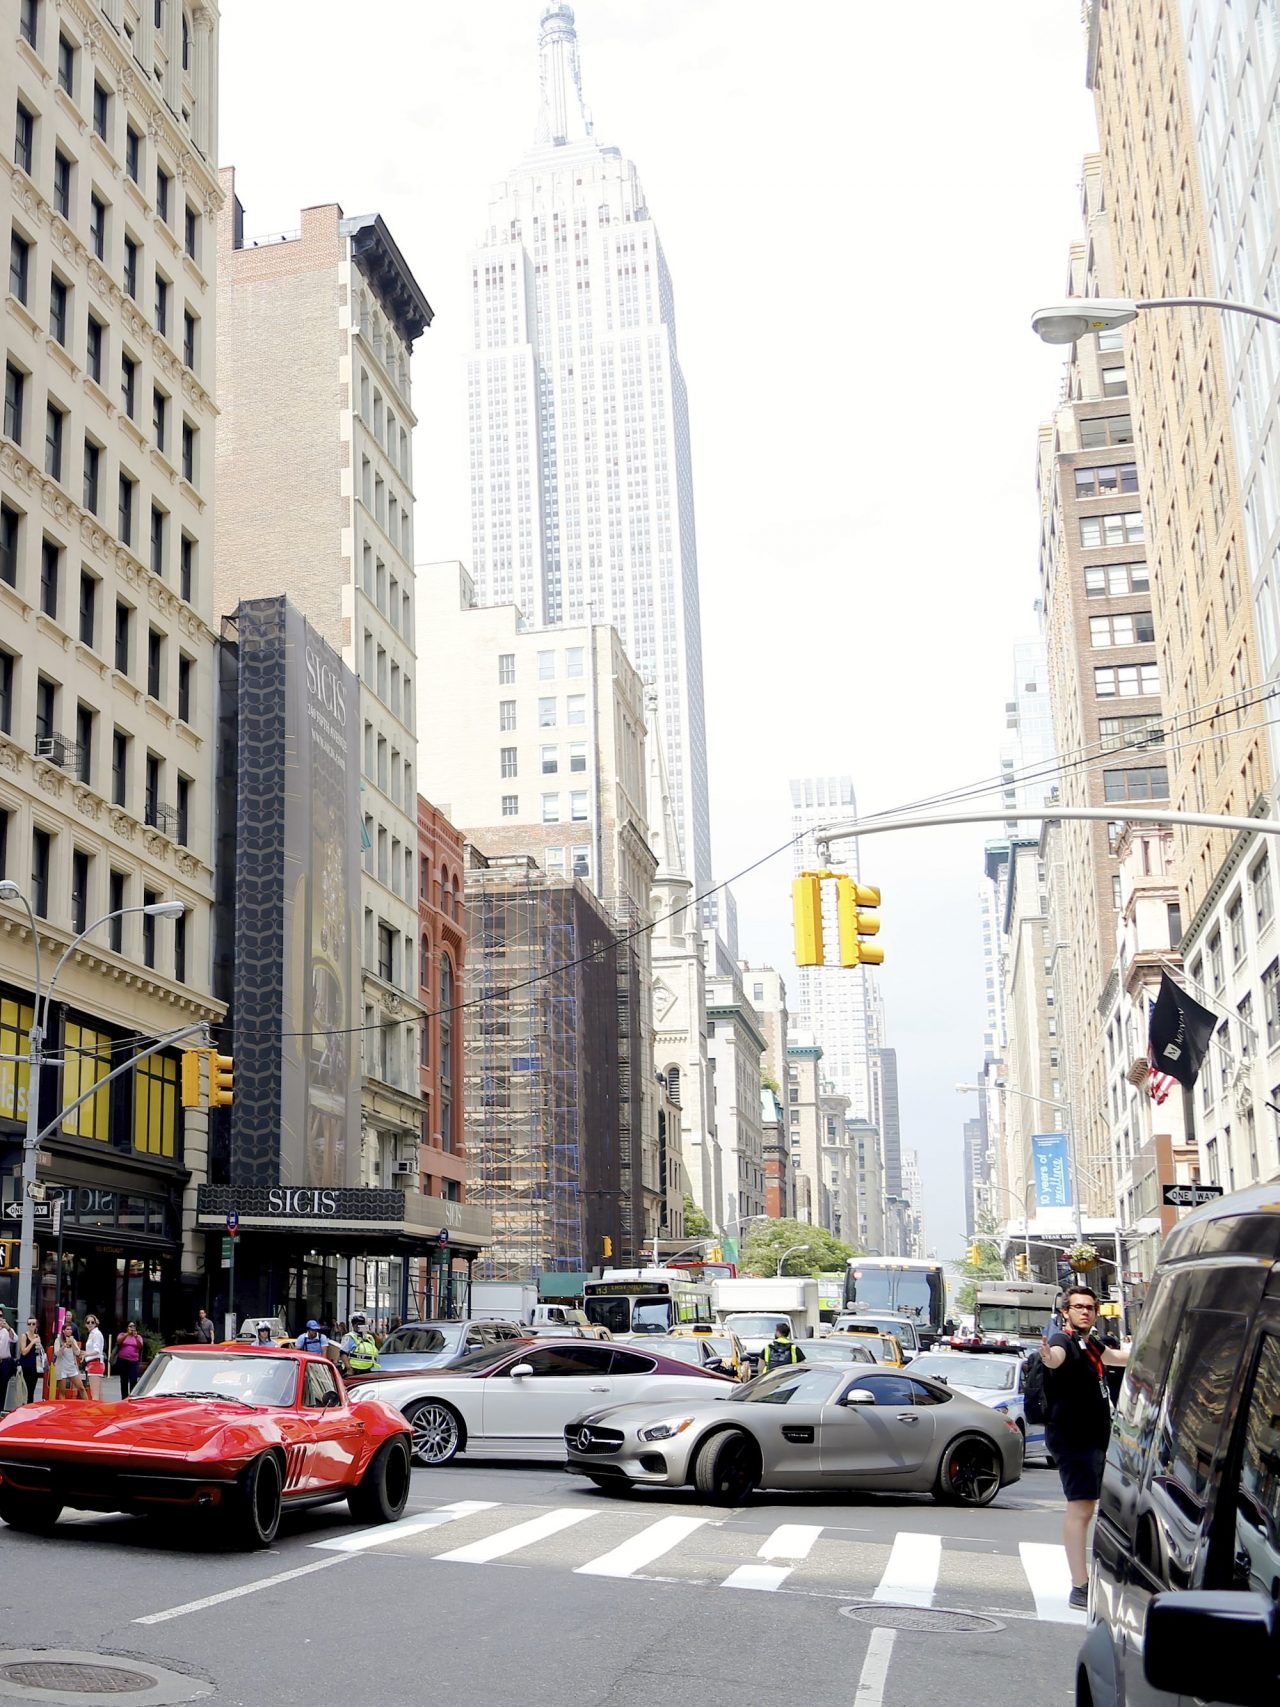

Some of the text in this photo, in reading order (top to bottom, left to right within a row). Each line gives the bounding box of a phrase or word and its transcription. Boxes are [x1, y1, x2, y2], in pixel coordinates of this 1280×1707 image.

[305, 646, 347, 727] SICIS
[1036, 1153, 1053, 1205] 10 years of
[268, 1188, 336, 1215] SICIS
[1172, 1191, 1216, 1201] ONE WAY
[10, 1206, 23, 1215] ONE
